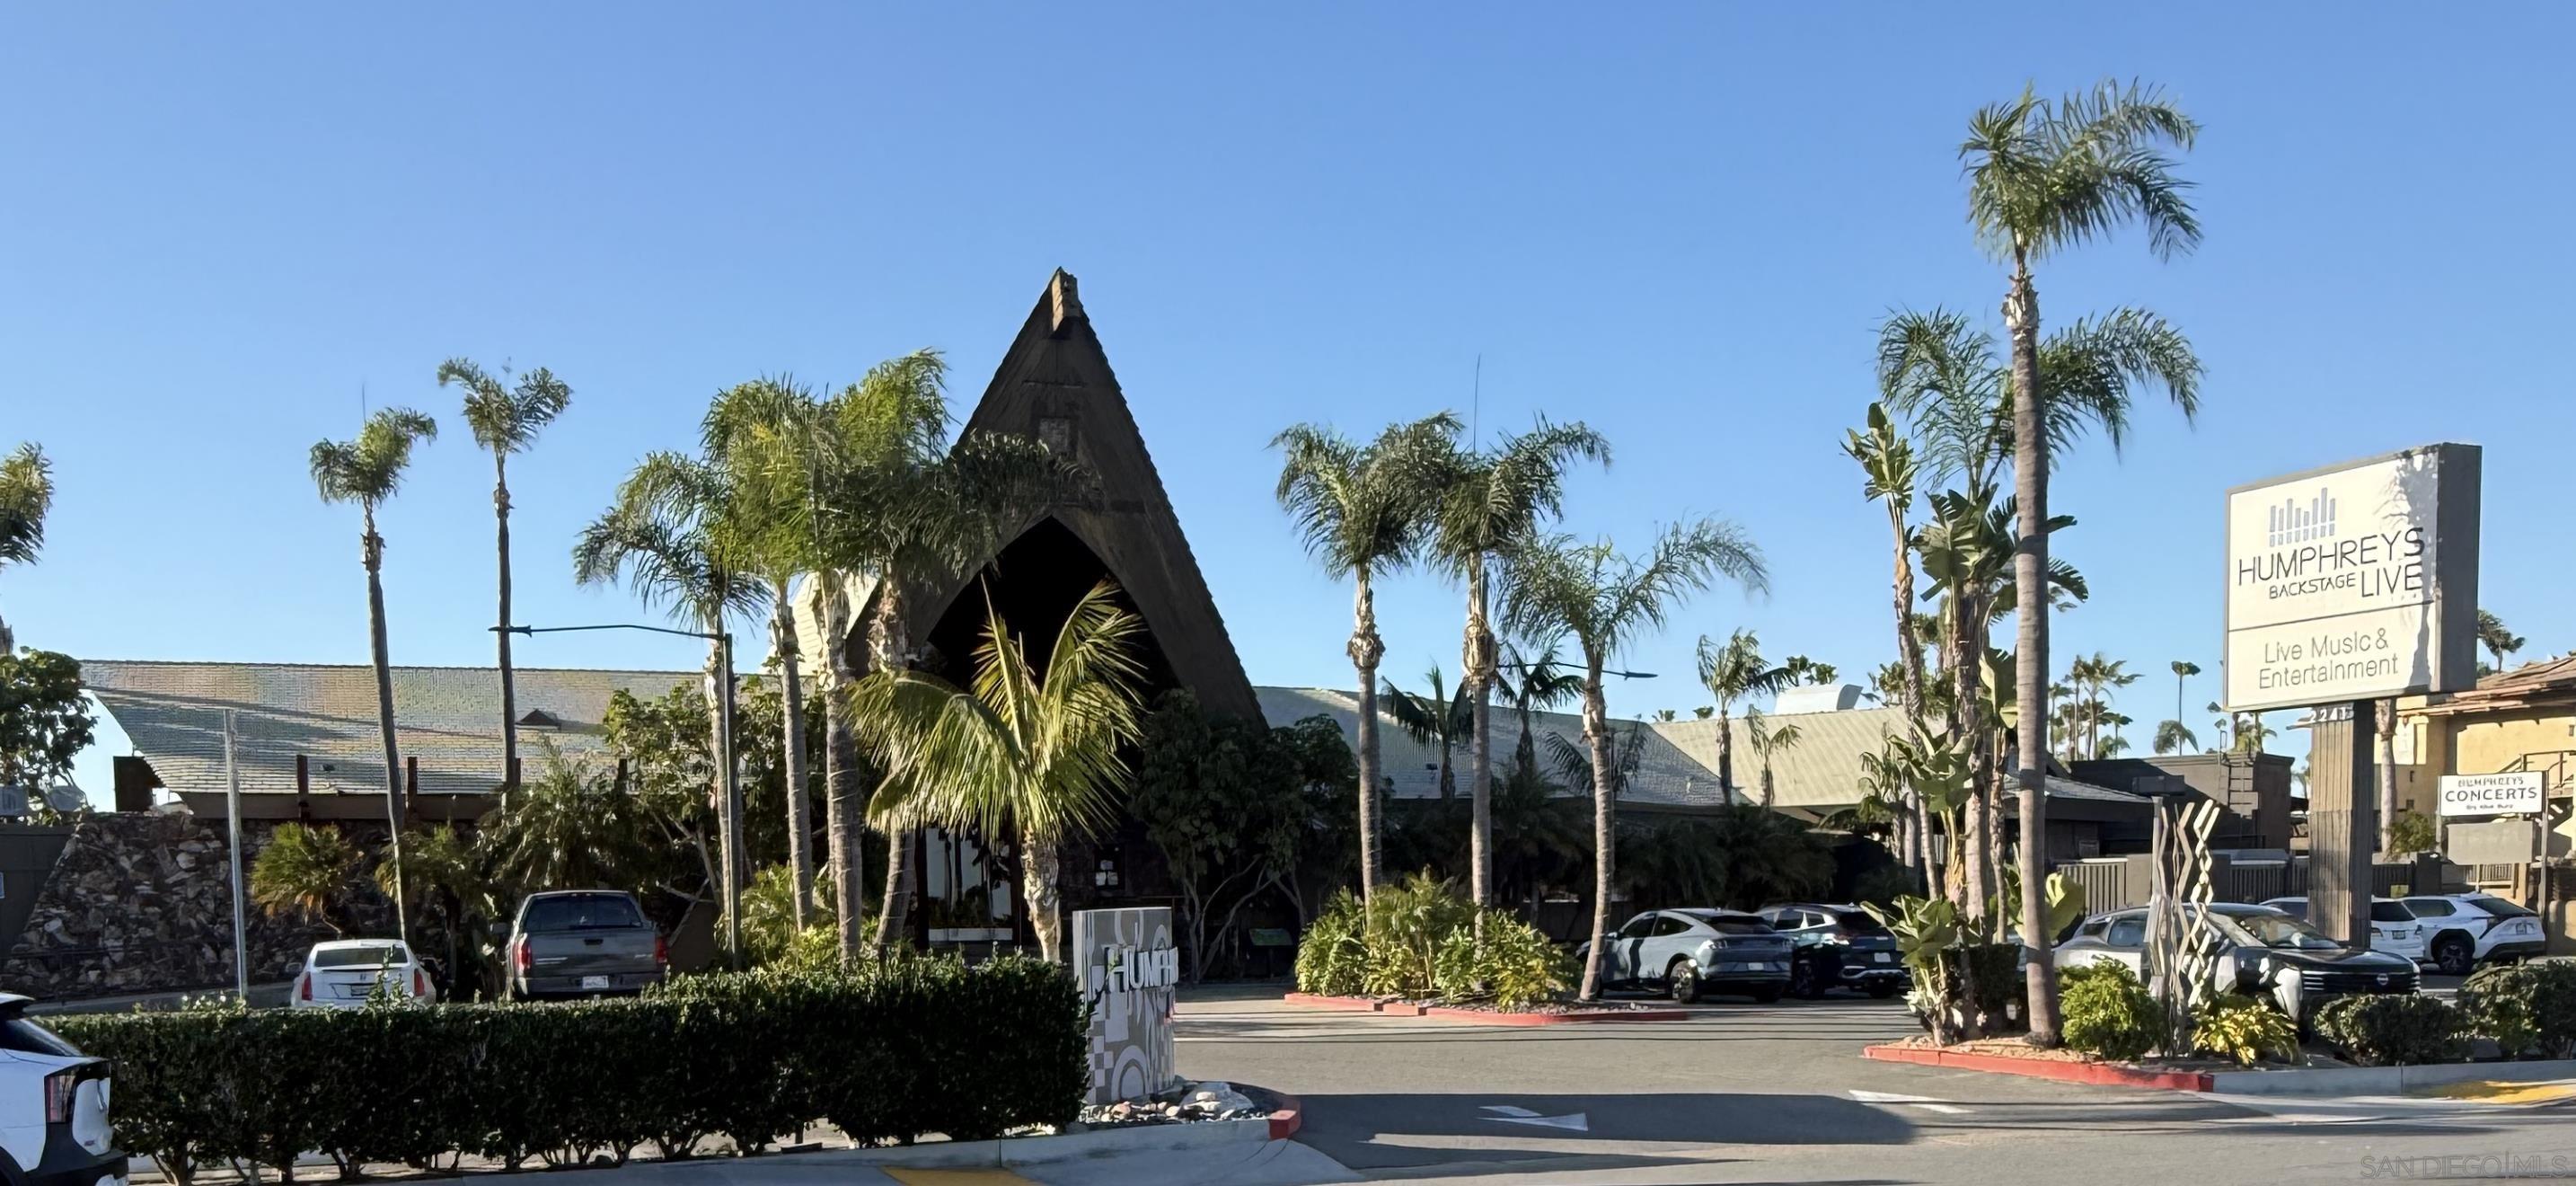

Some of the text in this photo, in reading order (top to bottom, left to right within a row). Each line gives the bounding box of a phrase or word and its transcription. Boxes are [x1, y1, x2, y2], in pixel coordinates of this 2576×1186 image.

[2238, 527, 2425, 586] HUMPHREYS
[2269, 560, 2423, 599] BACKSTAGE LIVE
[2264, 627, 2389, 664] Live Music &
[2259, 652, 2398, 690] Entertainment
[2445, 786, 2537, 802] CONCERTS
